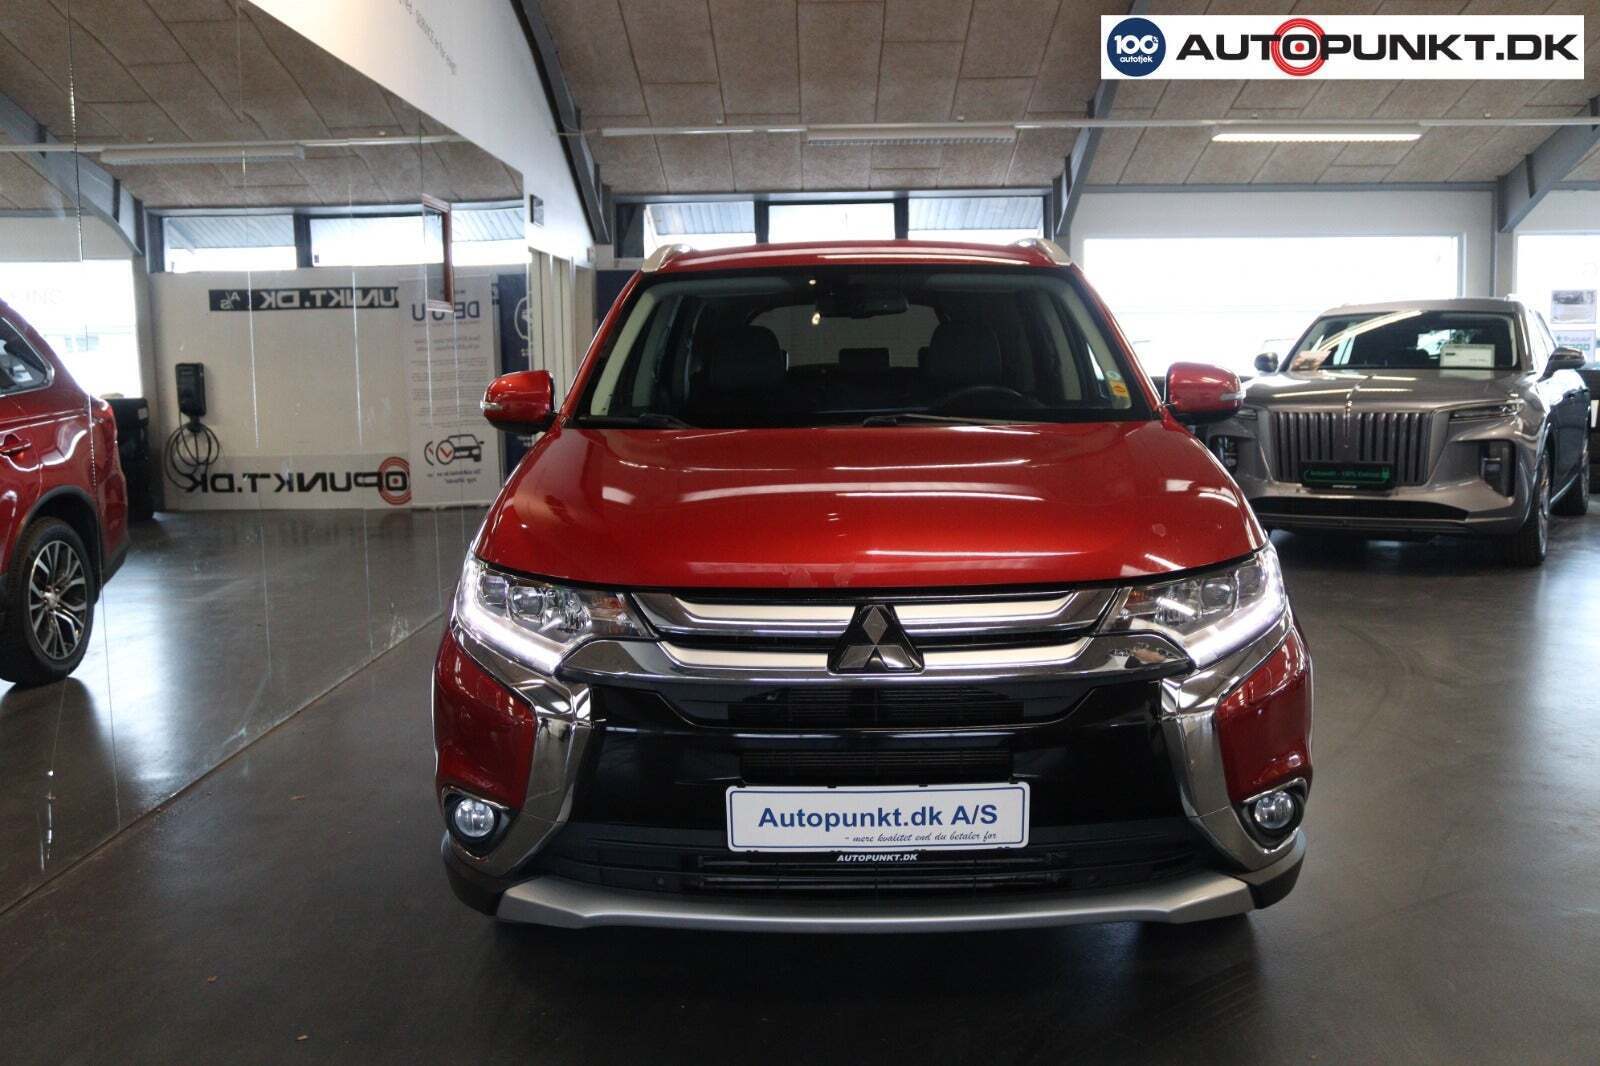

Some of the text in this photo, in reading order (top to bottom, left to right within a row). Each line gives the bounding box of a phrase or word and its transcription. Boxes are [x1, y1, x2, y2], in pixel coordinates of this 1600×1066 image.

[758, 804, 998, 832] Autopunkt.dk A/S
[852, 835, 874, 843] mere
[877, 832, 912, 842] kvalitet
[934, 832, 947, 840] du
[949, 831, 980, 841] betaler
[836, 853, 919, 862] AUTOPUNKT.DK
